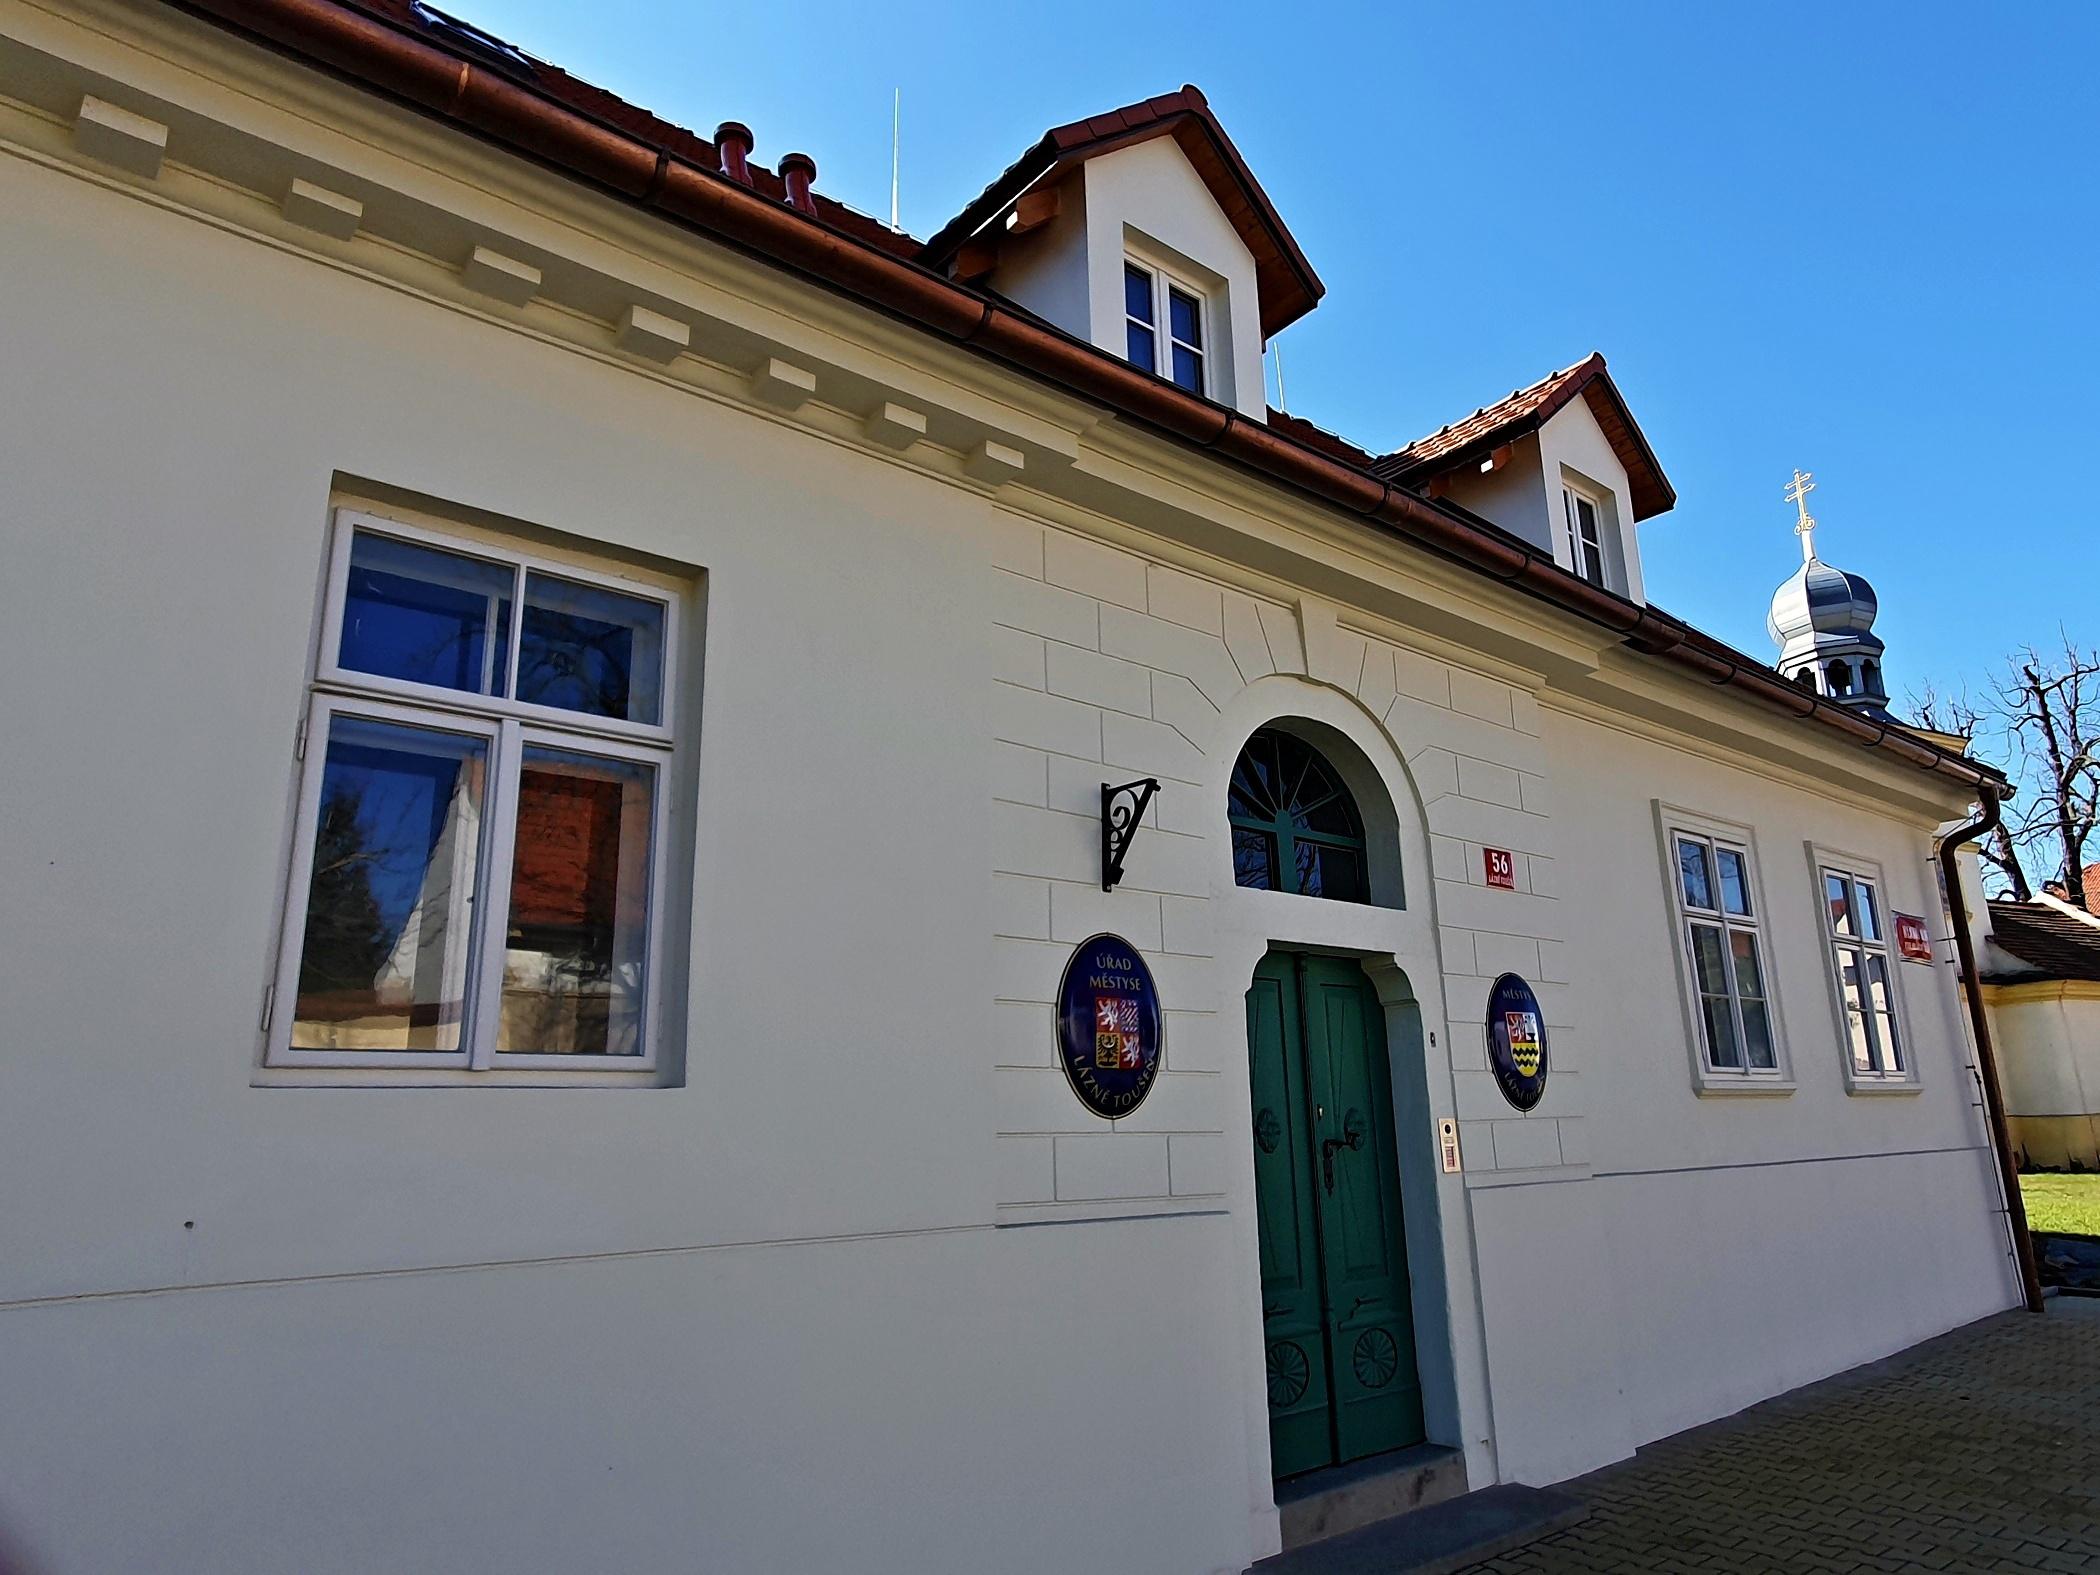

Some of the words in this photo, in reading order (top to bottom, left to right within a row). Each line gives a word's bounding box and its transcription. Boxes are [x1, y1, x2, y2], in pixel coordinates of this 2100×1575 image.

[1491, 852, 1508, 874] 56
[1096, 953, 1132, 971] ÚŘAD
[1089, 972, 1141, 991] MĚSTYSE
[1074, 1055, 1111, 1105] LÁZNĚ
